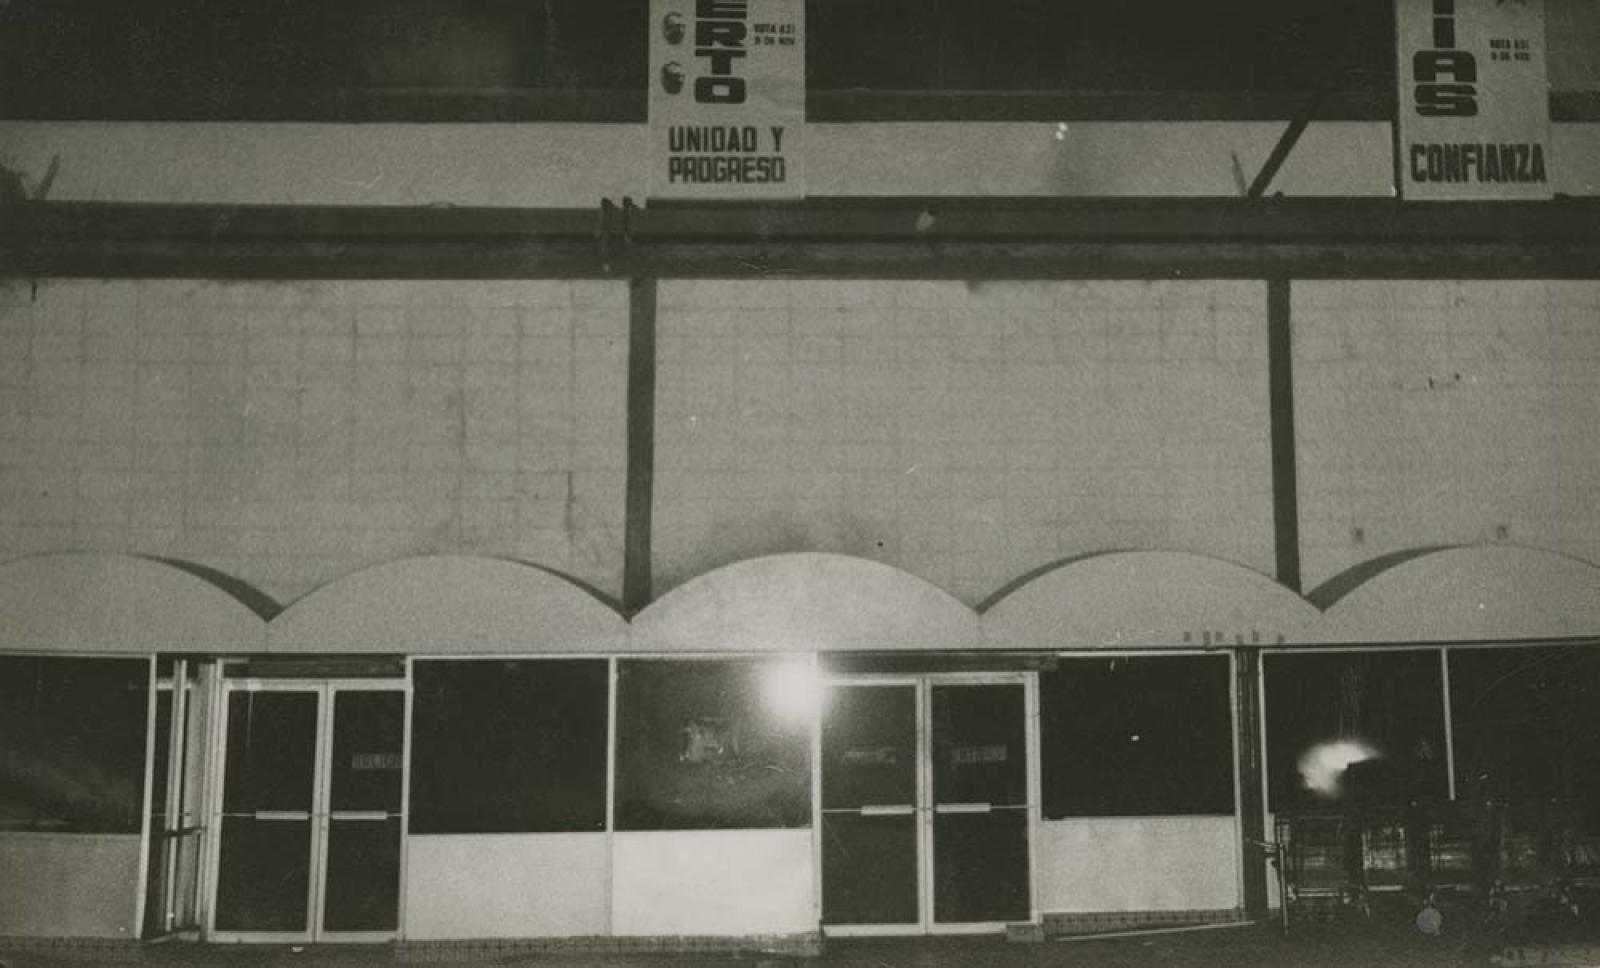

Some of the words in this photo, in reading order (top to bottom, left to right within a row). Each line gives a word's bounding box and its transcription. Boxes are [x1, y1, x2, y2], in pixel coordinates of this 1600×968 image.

[669, 126, 757, 152] UNIDAD
[771, 126, 784, 152] Y
[669, 156, 785, 183] PROGRESO
[1411, 143, 1547, 182] CONFIANZA
